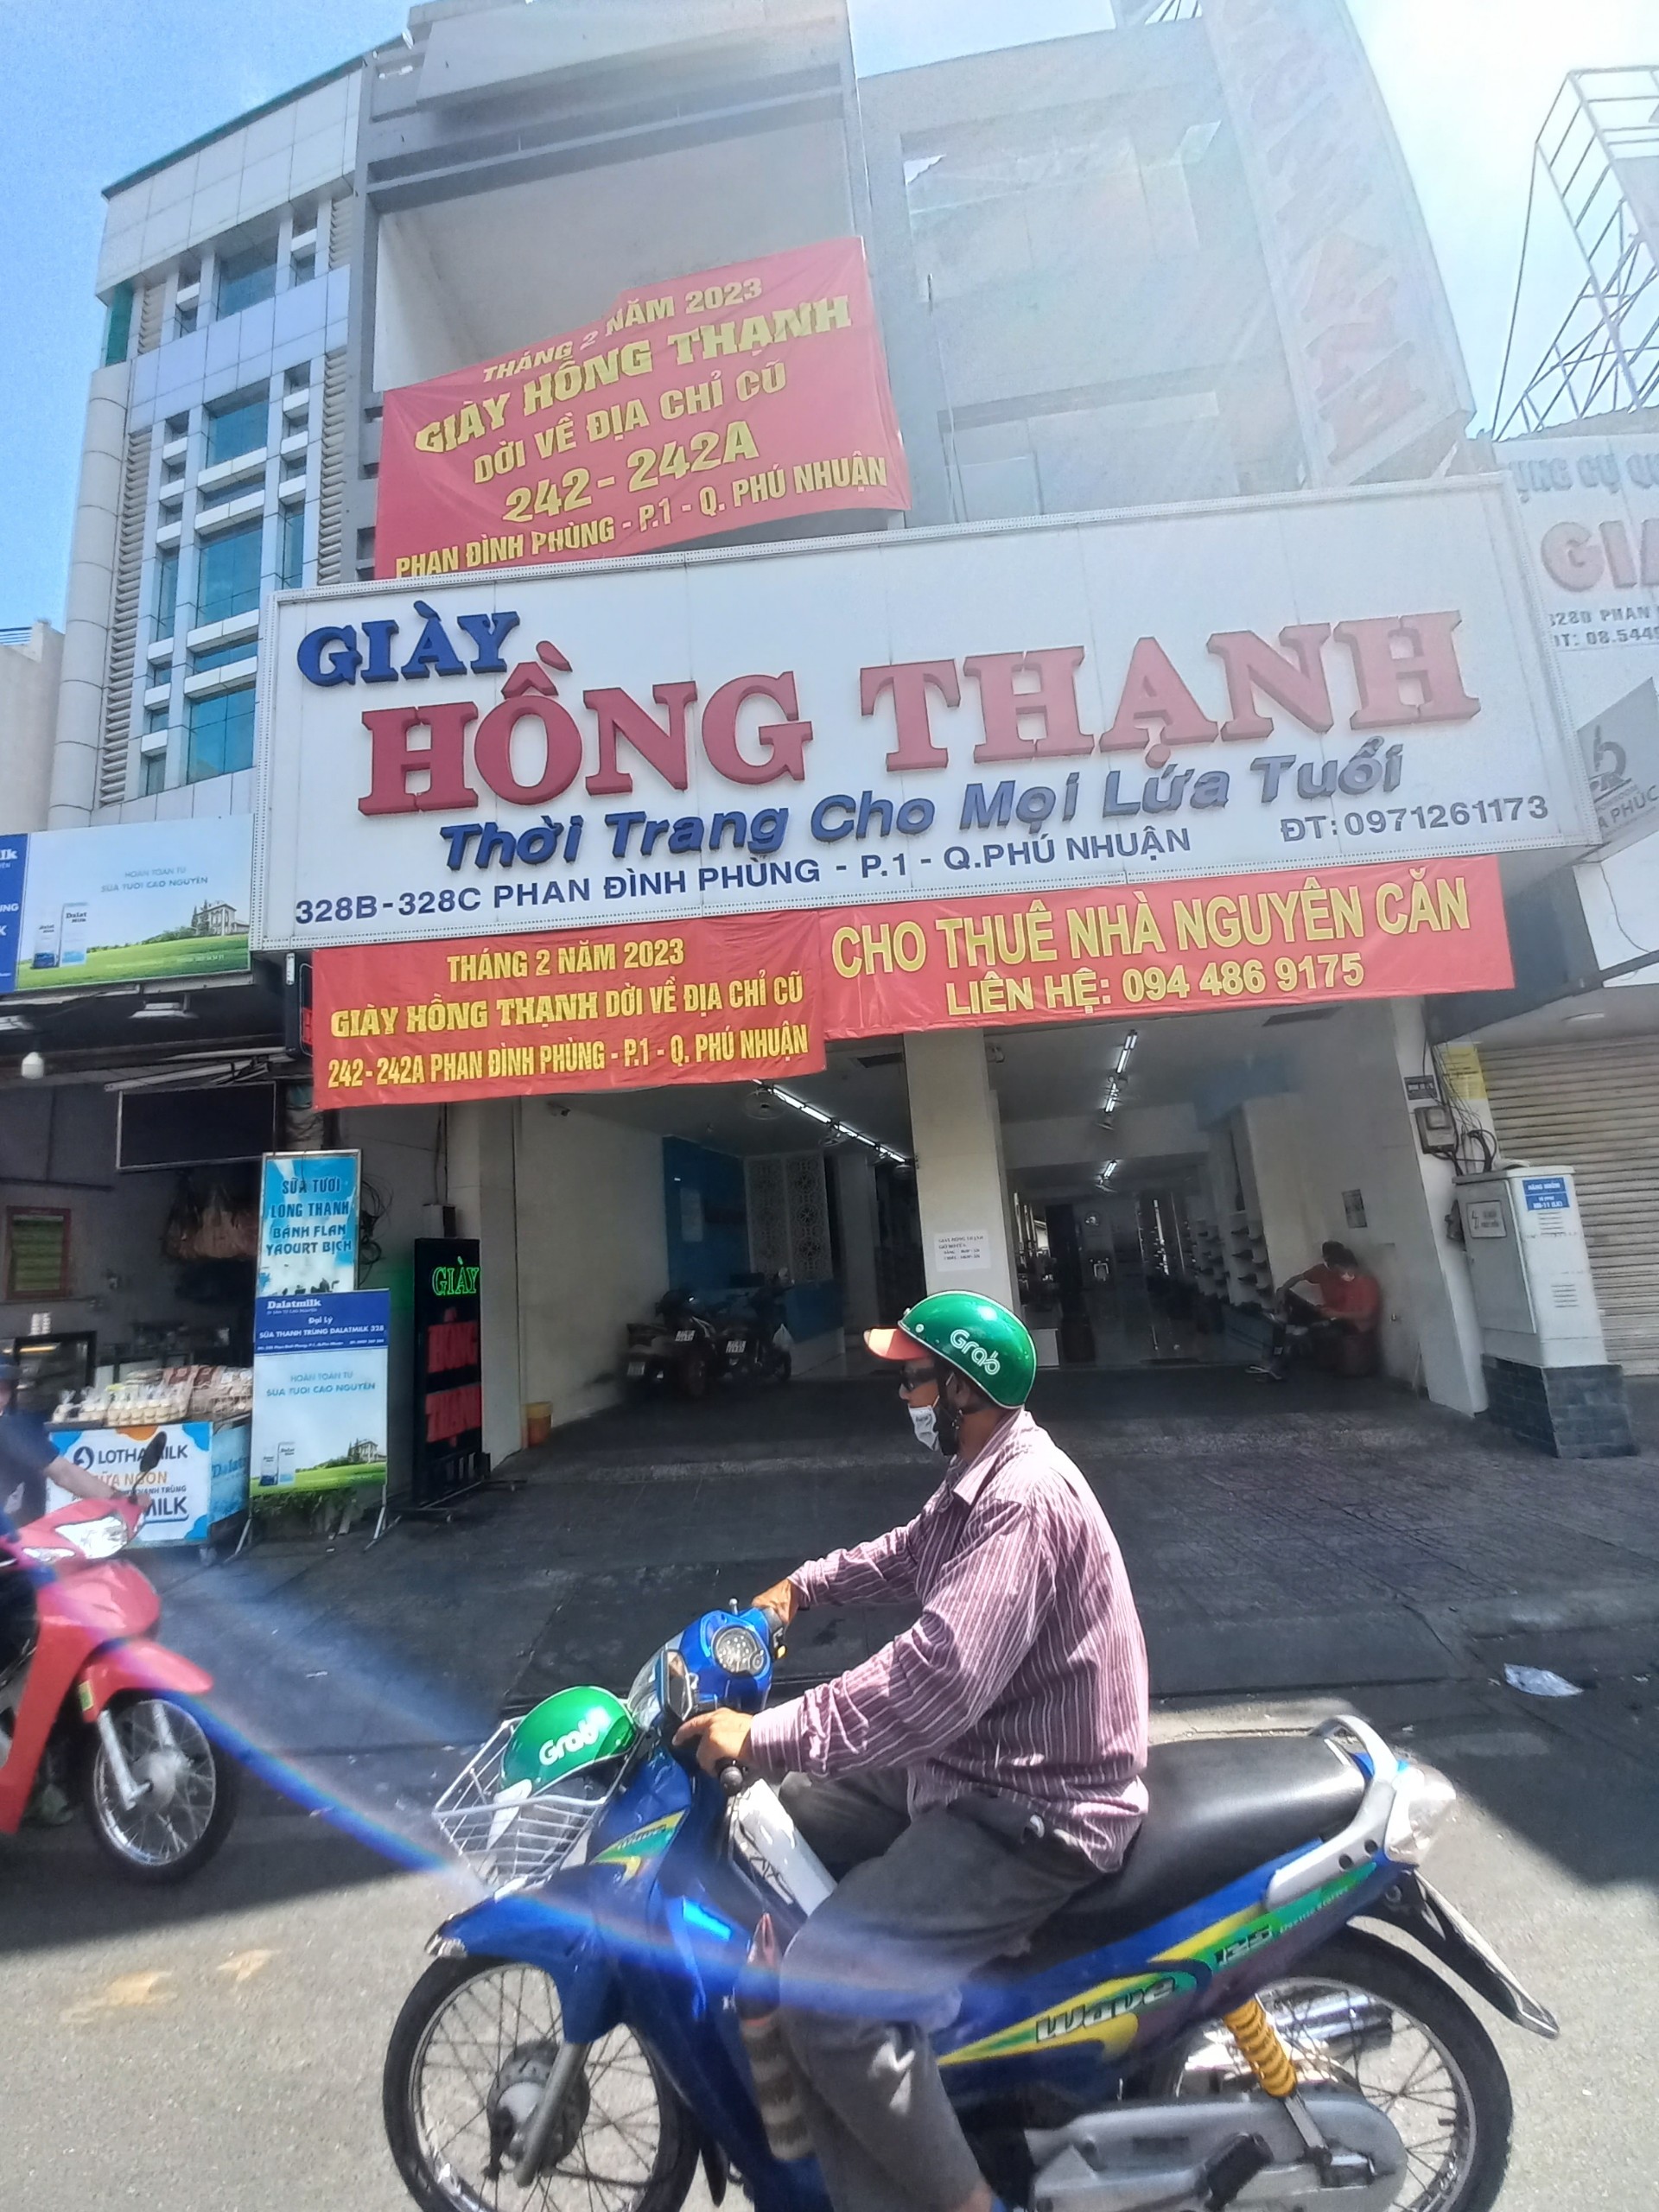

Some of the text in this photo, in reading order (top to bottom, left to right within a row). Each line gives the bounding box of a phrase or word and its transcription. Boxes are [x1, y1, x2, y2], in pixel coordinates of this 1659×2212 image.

[482, 276, 762, 384] THÁNG 2 NĂM 2023
[415, 294, 852, 454] GIÀY HỒNG THẠNH
[474, 359, 787, 484] DỜI VỀ ĐỊA CHỈ CŨ
[502, 420, 760, 523] 242 - 242A
[395, 542, 460, 579] PHAN
[465, 527, 525, 568] ĐÌNH
[531, 512, 615, 556] PHÙNG
[639, 503, 672, 533] P.1
[699, 489, 727, 518] Q.
[732, 464, 787, 508] PHÚ
[793, 450, 887, 494] NHUẬN
[297, 600, 520, 687] GIÀY
[1599, 605, 1649, 622] PHAN
[358, 609, 1483, 816] HỒNG THẠNH
[439, 735, 1403, 872] Thời Trang Cho Mọi Lứa Tuổi
[295, 887, 481, 925] 328B-328C
[493, 878, 590, 909] PHAN
[603, 865, 687, 900] ĐÌNH
[698, 855, 821, 892] PHÙNG
[861, 852, 907, 879] P.1
[1065, 826, 1191, 864] NHUẬN
[831, 866, 1471, 979] CHO THUÊ NHÀ NGUYÊN CĂN
[447, 937, 685, 983] THÁNG 2 NĂM 2023
[946, 951, 1364, 1016] LIÊN HỆ: 094 486 9175
[330, 1005, 398, 1039] GIÀY
[406, 991, 488, 1033] HỒNG
[496, 990, 600, 1033] THẠNH
[605, 985, 644, 1018] DỜI
[650, 976, 678, 1014] VỀ
[683, 982, 722, 1018] ĐỊA
[728, 974, 767, 1010] CHỈ
[773, 970, 804, 1004] CŨ
[430, 1050, 484, 1084] PHAN
[487, 1043, 535, 1078] ĐÌNH
[540, 1036, 606, 1072] PHÙNG
[623, 1037, 651, 1067] P.1
[670, 1035, 690, 1065] Q.
[695, 1025, 735, 1063] PHÚ
[740, 1020, 810, 1062] NHUẬN
[270, 1203, 303, 1218] LONG
[282, 1178, 308, 1195] SỮA
[265, 1240, 353, 1256] YAOURT BỊCH
[272, 1224, 346, 1239] BÁNH FLAN
[432, 1255, 480, 1296] GIÀY
[276, 1329, 302, 1338] THANH
[330, 1325, 369, 1335] DALATMILK
[950, 1328, 1001, 1376] Grab
[313, 1384, 334, 1394] CAO
[98, 1444, 188, 1465] LOTHAILK
[538, 1707, 607, 1766] Grab
